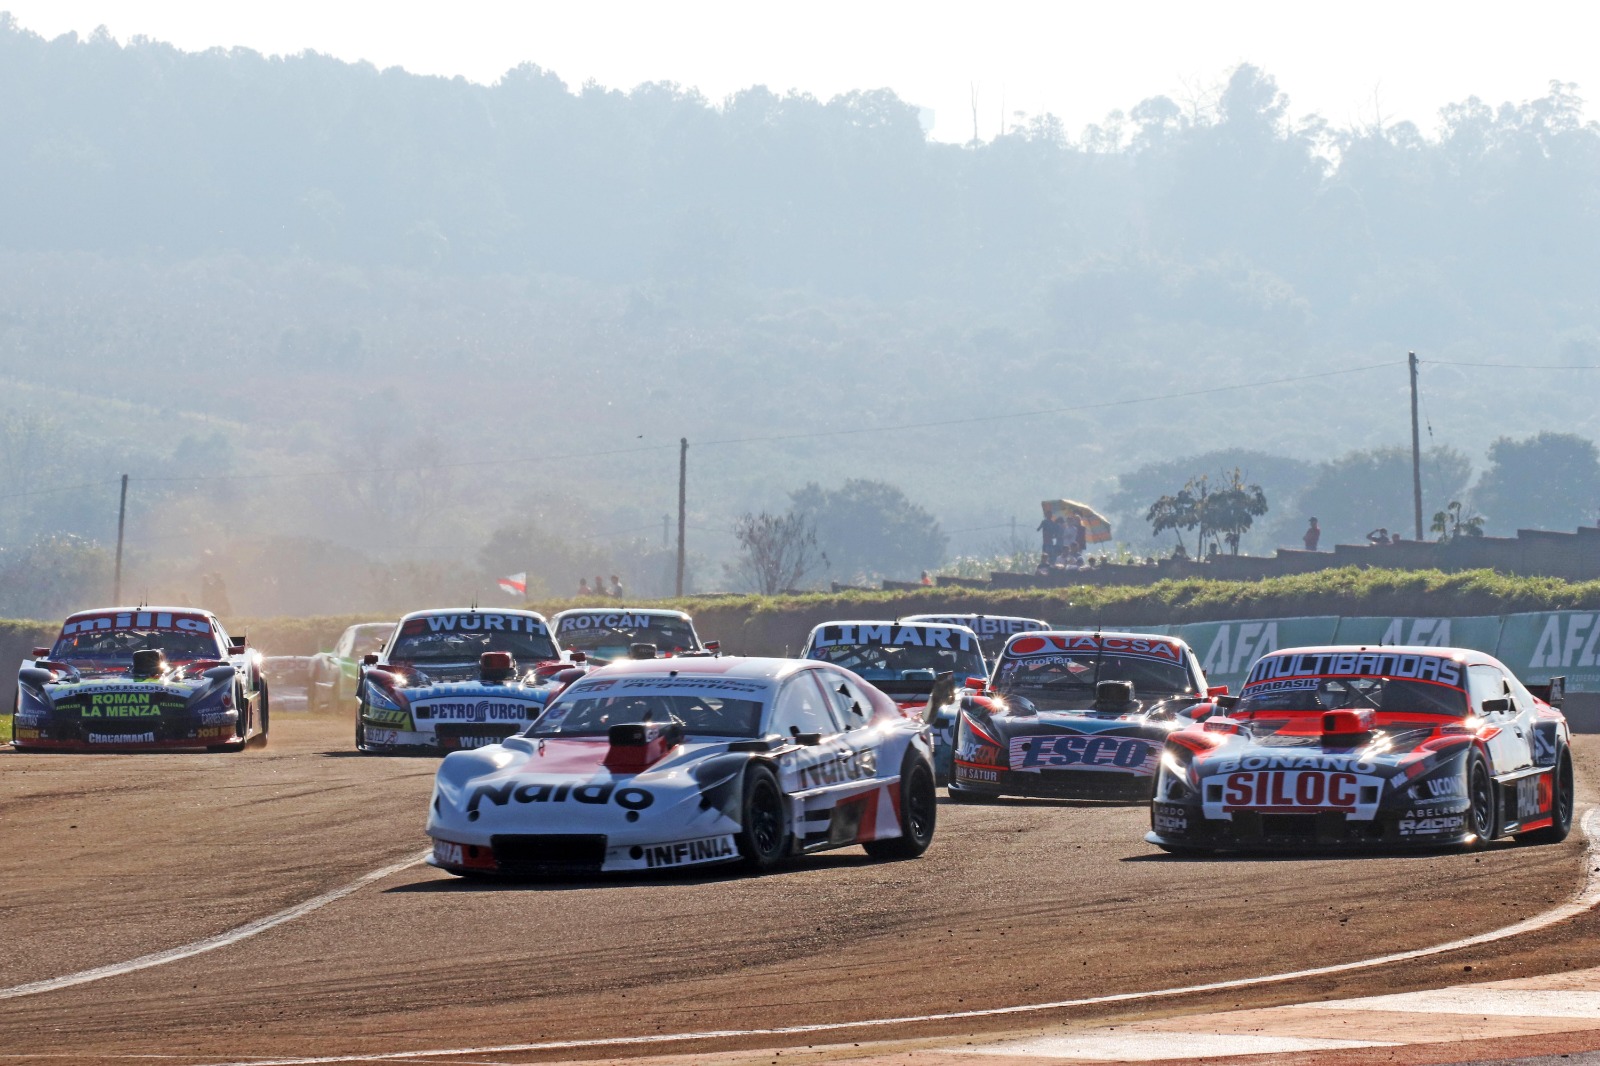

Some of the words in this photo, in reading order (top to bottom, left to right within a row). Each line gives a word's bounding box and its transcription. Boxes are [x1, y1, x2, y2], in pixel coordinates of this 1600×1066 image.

[63, 612, 210, 635] milla
[426, 614, 547, 636] WÜRTH
[814, 625, 977, 650] LIMART
[1059, 637, 1176, 659] TACSA
[1250, 654, 1461, 685] MULTIBANDAS
[622, 682, 757, 693] Argentina
[1244, 678, 1318, 696] TRABASIL
[92, 693, 151, 704] ROMAN
[81, 706, 102, 717] LA
[106, 704, 162, 717] MENZA
[1021, 737, 1152, 768] ESCO
[969, 768, 998, 781] SATUR
[1216, 755, 1378, 774] BONANO
[465, 782, 655, 812] Naldo
[1225, 771, 1358, 806] SILOC
[645, 838, 733, 867] INFINIA
